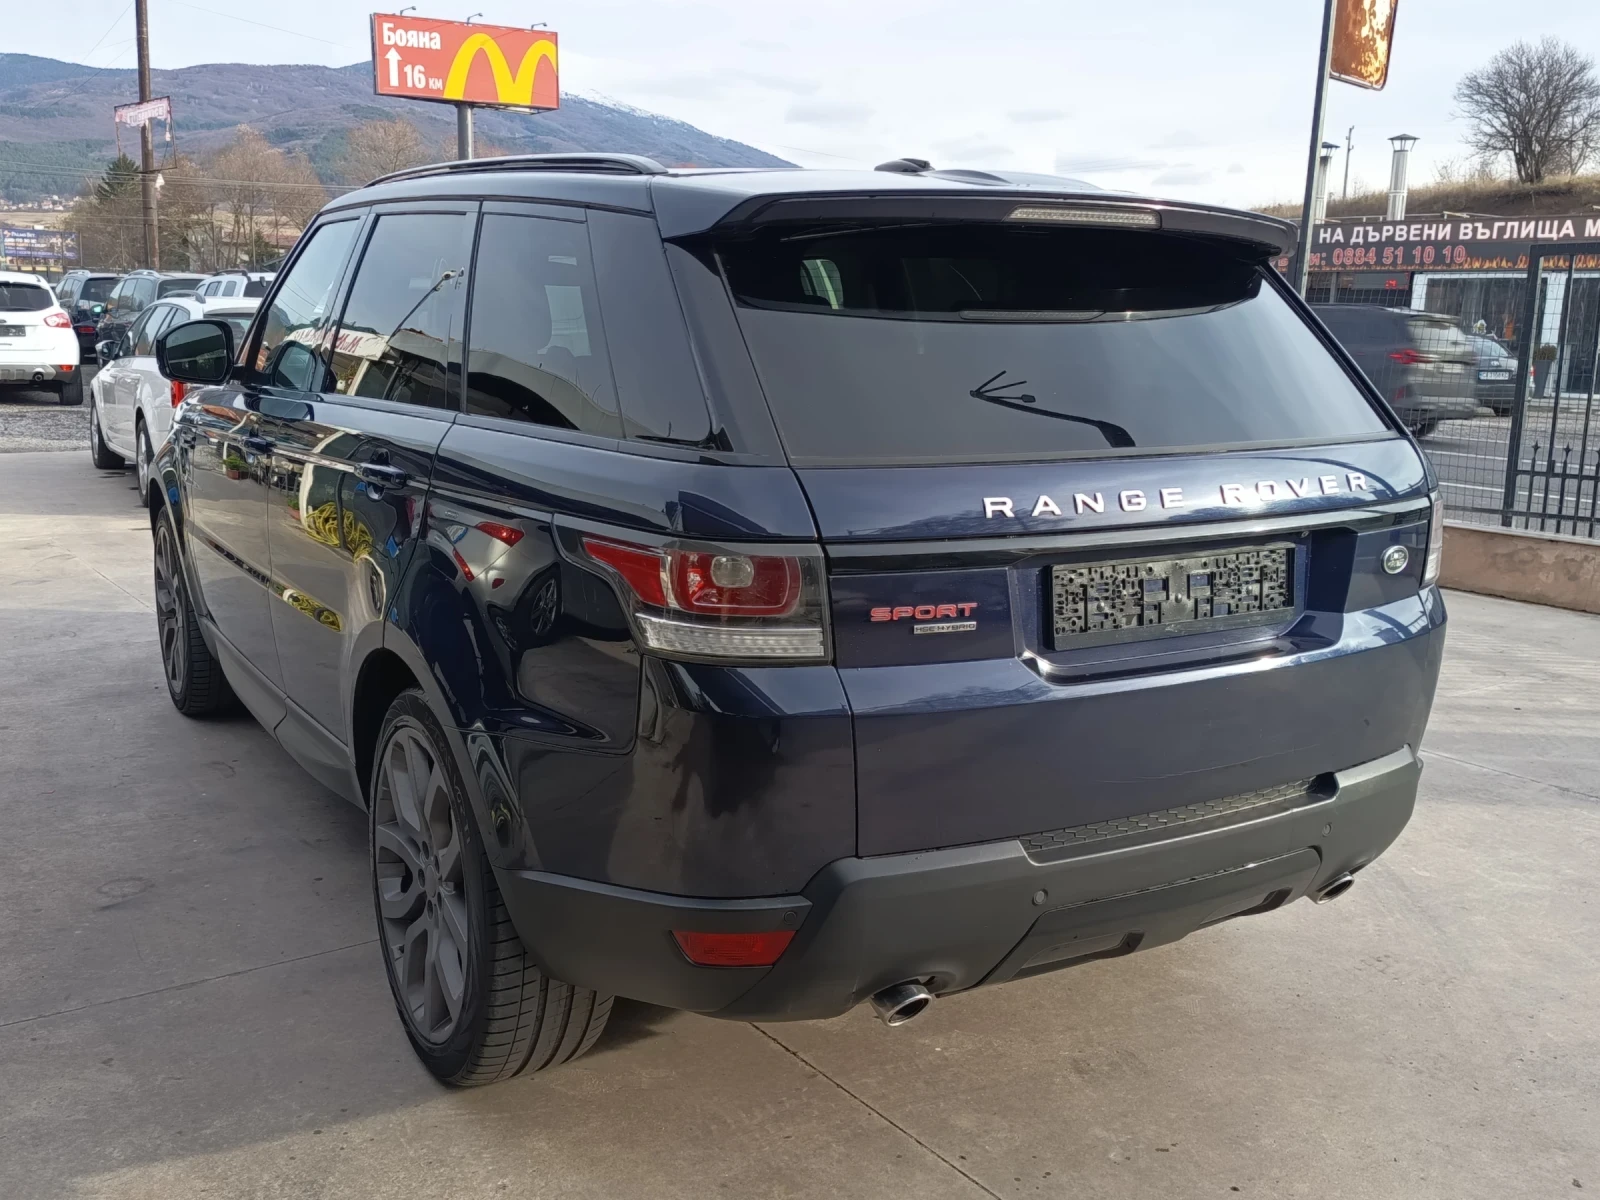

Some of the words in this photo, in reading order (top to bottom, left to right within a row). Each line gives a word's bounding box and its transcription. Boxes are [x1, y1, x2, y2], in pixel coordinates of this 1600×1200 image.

[382, 22, 441, 50] Бояна
[403, 64, 426, 89] 16
[428, 77, 443, 91] км
[1319, 227, 1344, 244] НА
[1350, 223, 1452, 246] ДЪРВЕНИ
[1458, 219, 1576, 241] ВЪГЛИЩА
[1332, 247, 1376, 265] 0884
[1382, 246, 1403, 264] 51
[1412, 245, 1435, 264] 10
[1443, 244, 1466, 264] 10
[983, 486, 1184, 519] RANGE
[1219, 472, 1368, 505] ROVER
[870, 602, 978, 622] SPORT
